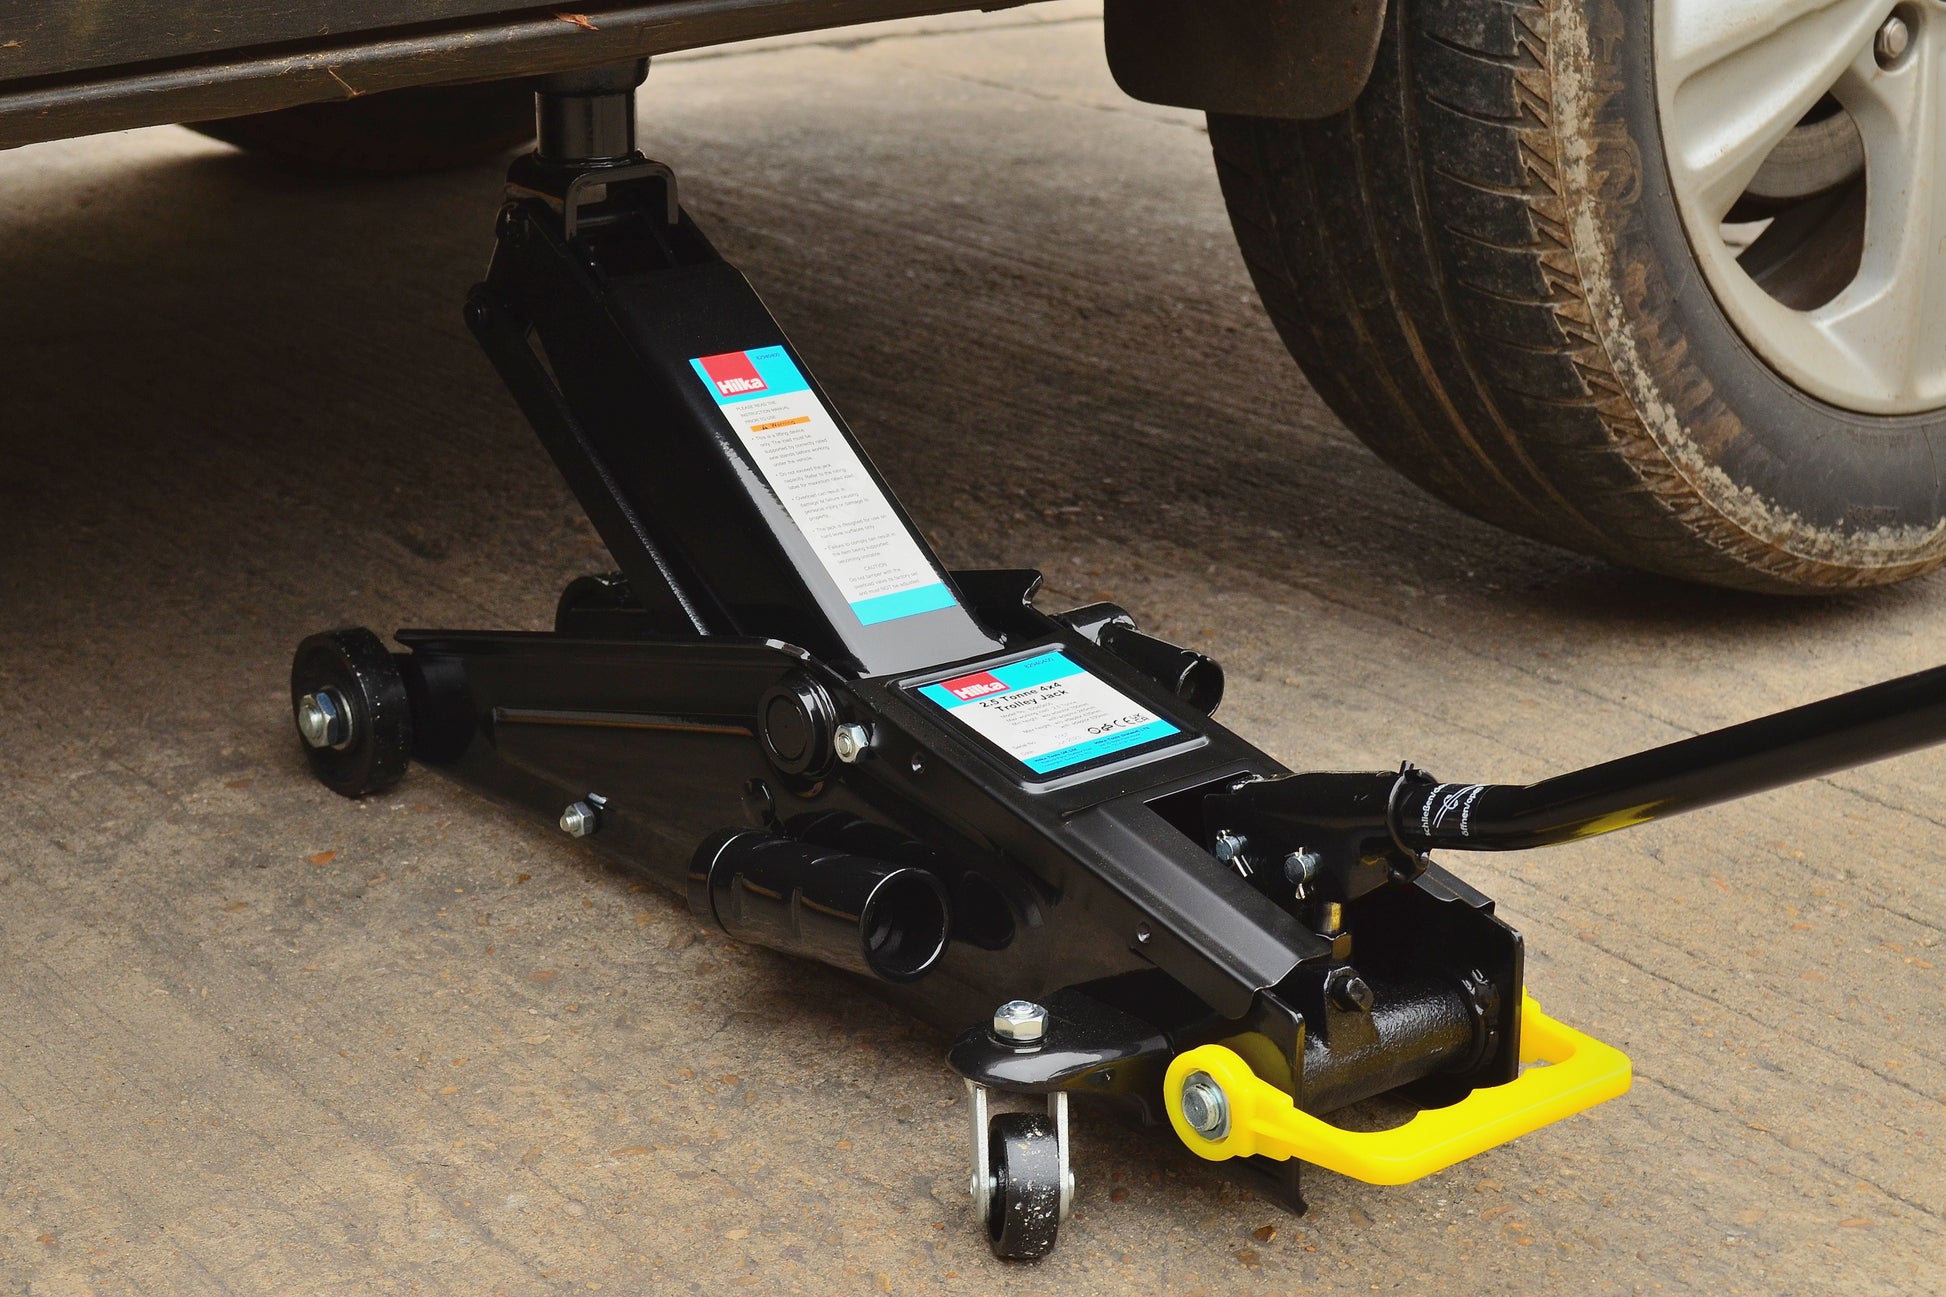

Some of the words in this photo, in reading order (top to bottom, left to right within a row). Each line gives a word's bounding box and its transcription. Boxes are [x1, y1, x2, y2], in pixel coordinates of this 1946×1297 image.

[716, 378, 764, 394] Hilka
[953, 682, 1006, 699] Hilka
[979, 699, 999, 708] 2.5
[999, 690, 1038, 702] Tonne
[1040, 682, 1062, 691] 4x4
[994, 698, 1038, 712] Trolley
[1040, 690, 1068, 700] Jack
